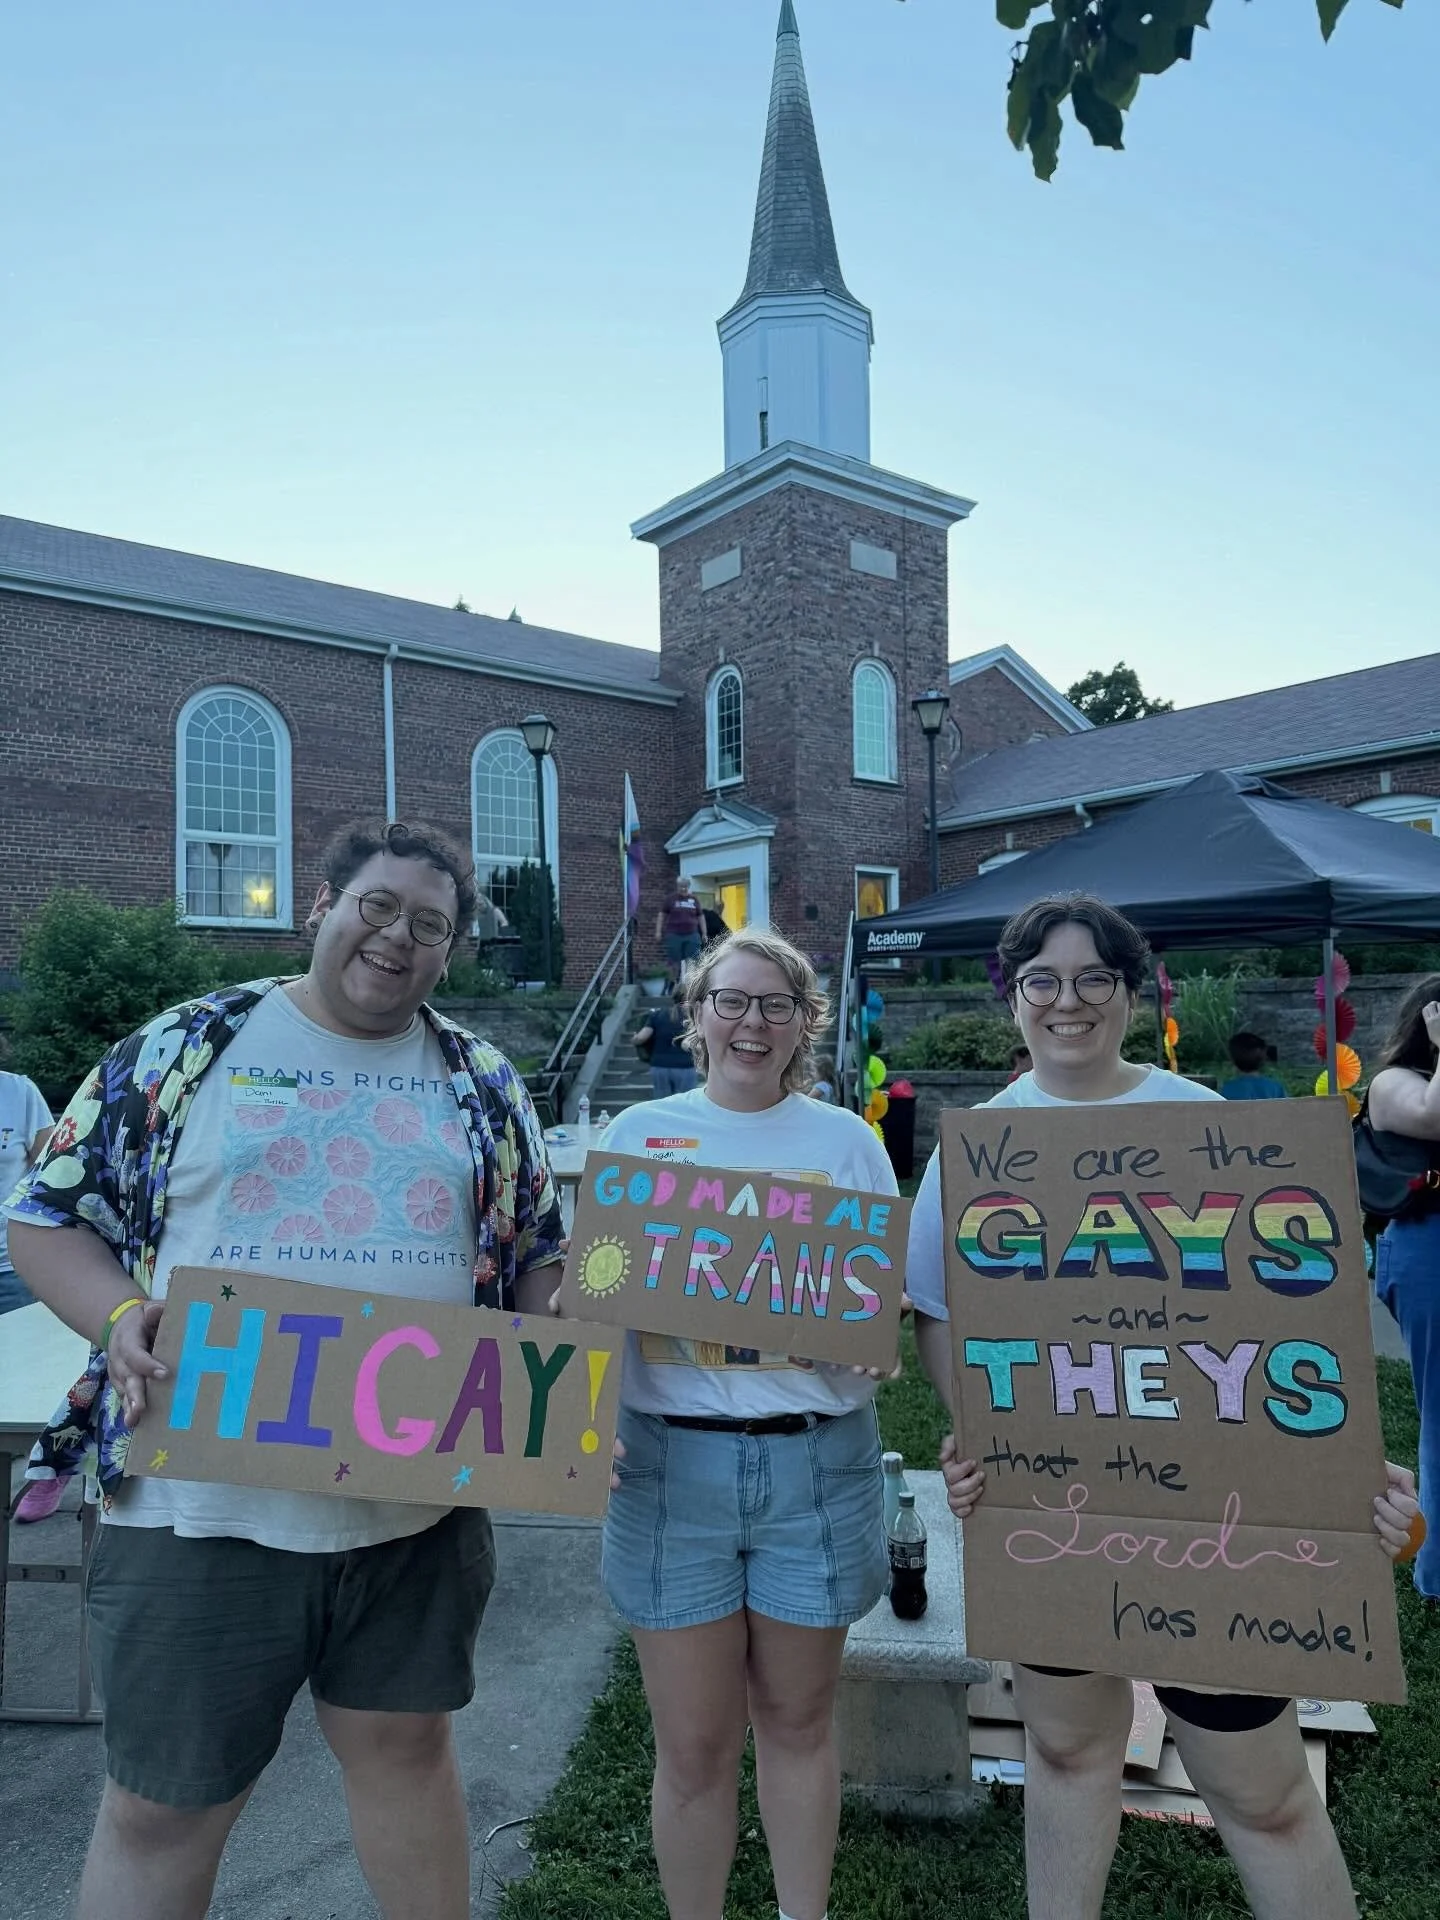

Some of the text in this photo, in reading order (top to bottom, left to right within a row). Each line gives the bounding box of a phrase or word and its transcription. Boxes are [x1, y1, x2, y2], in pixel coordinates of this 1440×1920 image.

[867, 930, 923, 948] Academy
[227, 1066, 456, 1096] TRANS RIGHTS
[960, 1125, 1296, 1182] We are the
[594, 1166, 891, 1237] GOD MADE ME
[210, 1245, 468, 1267] ARE HUMAN RIGHTS
[642, 1222, 893, 1322] TRANS
[955, 1185, 1342, 1297] GAYS
[168, 1301, 612, 1457] HI GAY!
[963, 1337, 1350, 1438] THEYS
[983, 1436, 1188, 1491] that the
[1113, 1580, 1374, 1661] has made!
